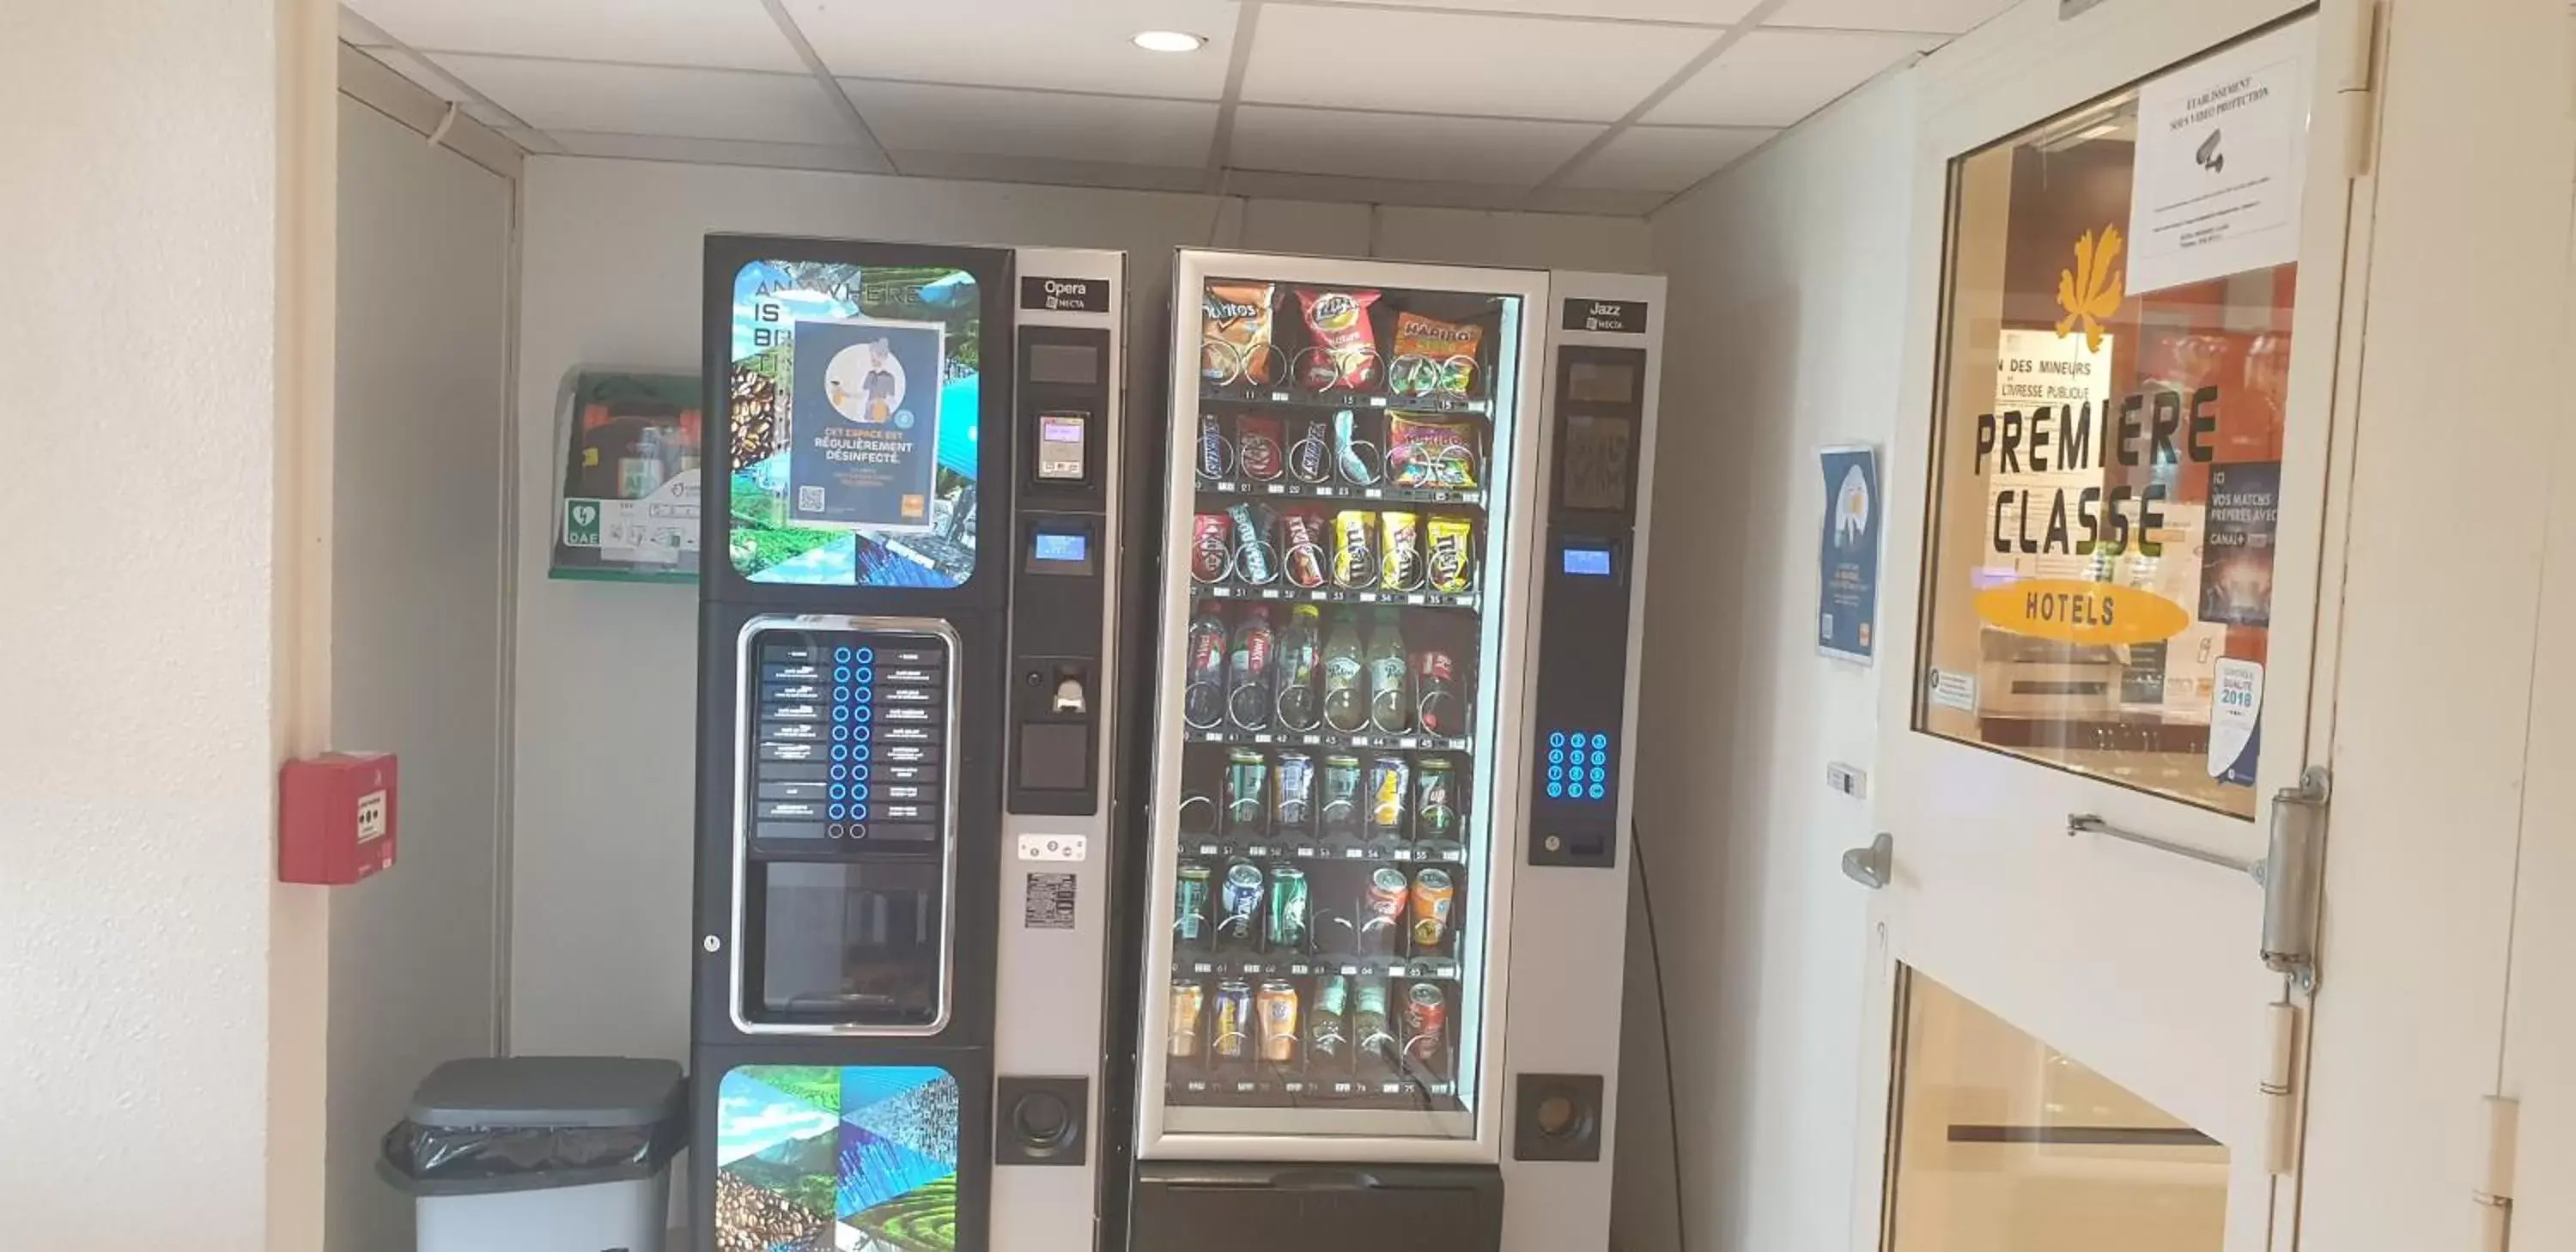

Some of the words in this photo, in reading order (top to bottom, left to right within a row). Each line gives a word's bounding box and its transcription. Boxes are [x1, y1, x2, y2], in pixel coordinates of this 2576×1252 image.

[2216, 87, 2268, 116] PROTECTION
[1045, 280, 1086, 296] Opera
[755, 303, 779, 322] IS
[1589, 302, 1621, 317] Jazz
[2010, 358, 2033, 373] DES
[2039, 360, 2092, 375] MINEURS
[1974, 385, 2219, 477] PREMIERE
[814, 436, 914, 453] RÉGULIÈREMENT
[2212, 494, 2231, 507] VOS
[1993, 483, 2167, 557] CLASSE
[569, 532, 599, 544] DAE
[2026, 592, 2115, 626] HOTELS
[2221, 689, 2253, 708] 2018
